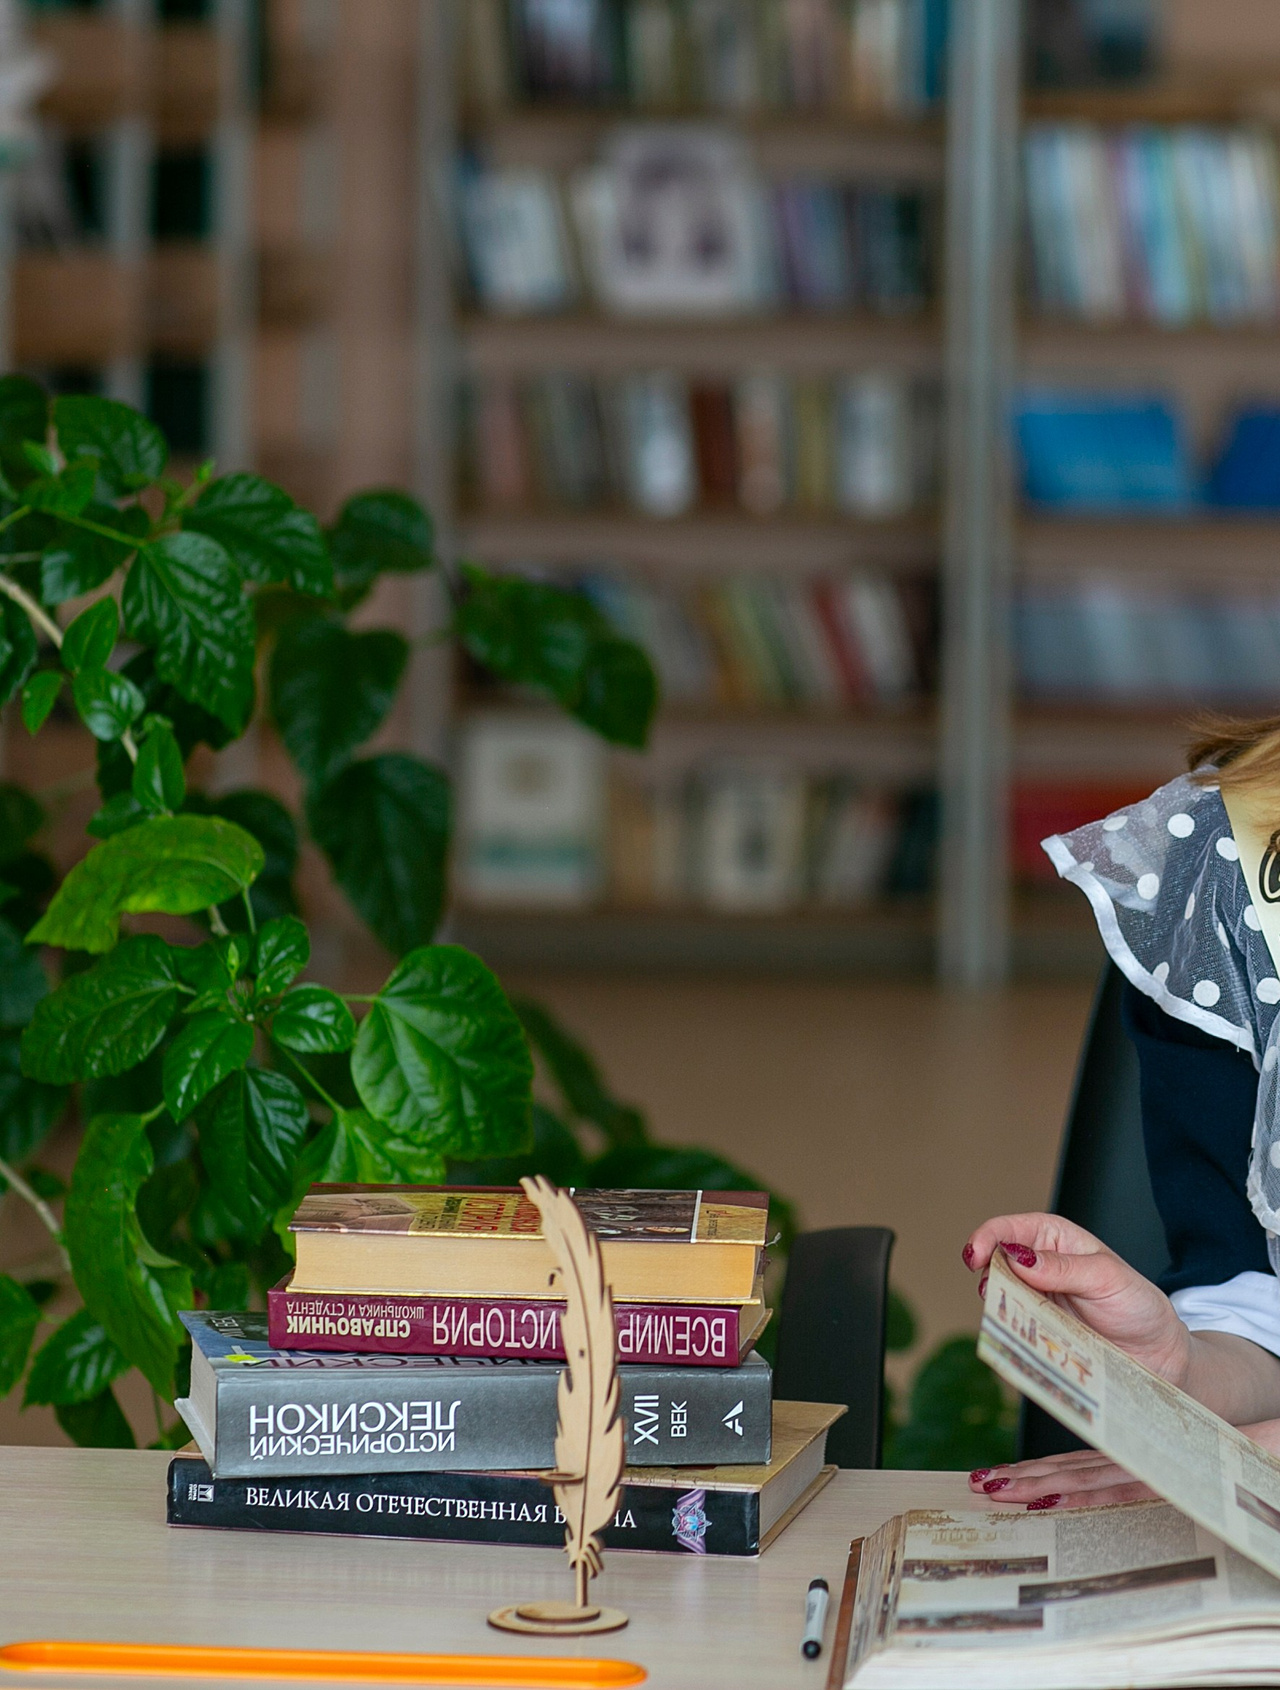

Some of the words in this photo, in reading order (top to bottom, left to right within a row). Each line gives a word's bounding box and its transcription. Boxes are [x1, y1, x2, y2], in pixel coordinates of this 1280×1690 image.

[286, 1301, 345, 1317] СТУДЕНТА
[349, 1302, 357, 1316] И
[358, 1304, 424, 1319] ШКОЛЬНИКА
[286, 1316, 411, 1339] СПРАВОЧНИК
[433, 1305, 556, 1350] ИСТОРИЯ
[618, 1313, 727, 1358] ВСЕМИР
[250, 1400, 461, 1435] ЛЕКСИКОН
[634, 1395, 659, 1445] XVII
[670, 1400, 687, 1437] ВЕК
[250, 1431, 455, 1460] ИСТОРИЧЕСКИЙ
[245, 1486, 350, 1512] ВЕЛИКАЯ
[355, 1493, 549, 1523] ОТЕЧЕСТВЕННАЯ
